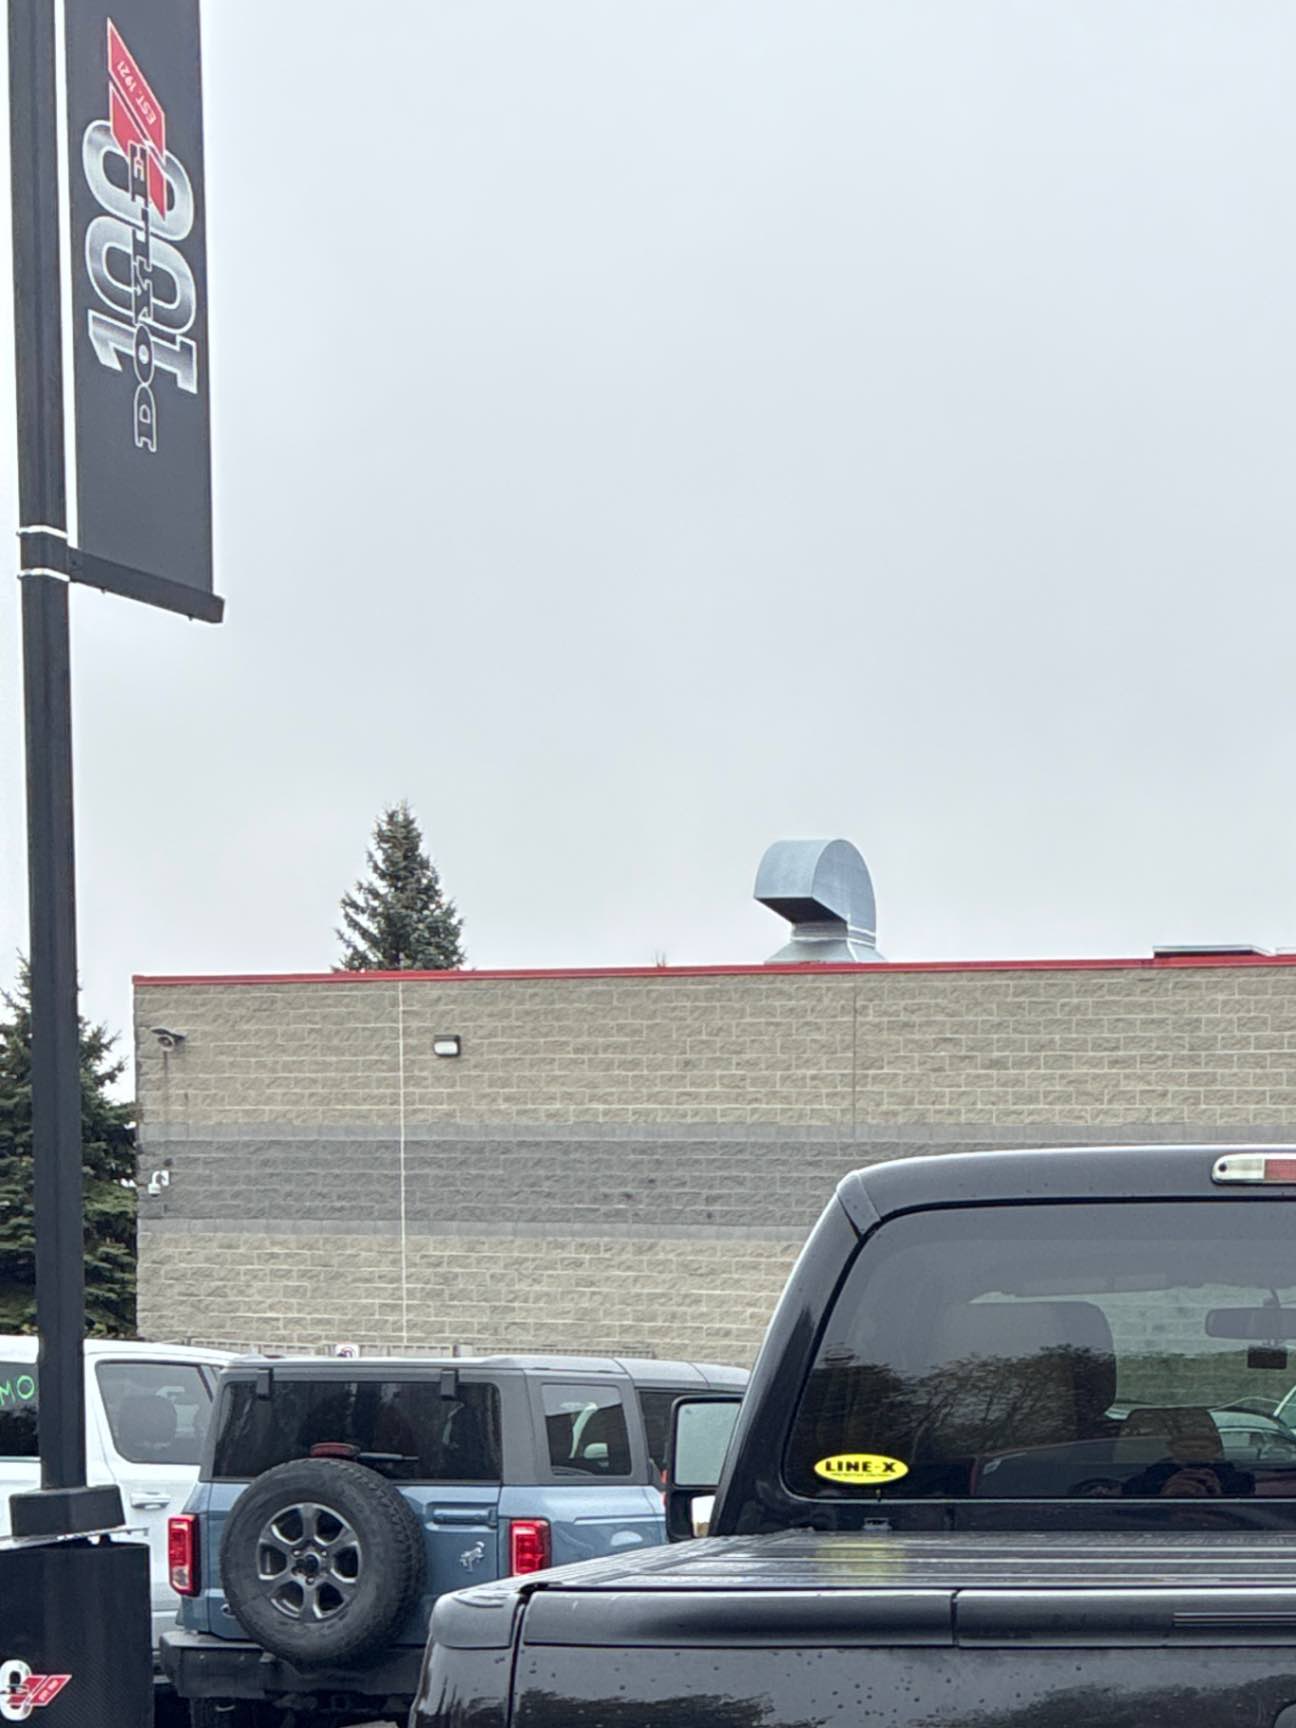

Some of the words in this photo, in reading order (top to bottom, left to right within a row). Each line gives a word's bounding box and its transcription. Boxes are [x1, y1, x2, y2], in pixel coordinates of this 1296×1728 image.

[82, 119, 198, 394] 100
[127, 139, 157, 452] DOYLE
[825, 1461, 896, 1473] LINE-X
